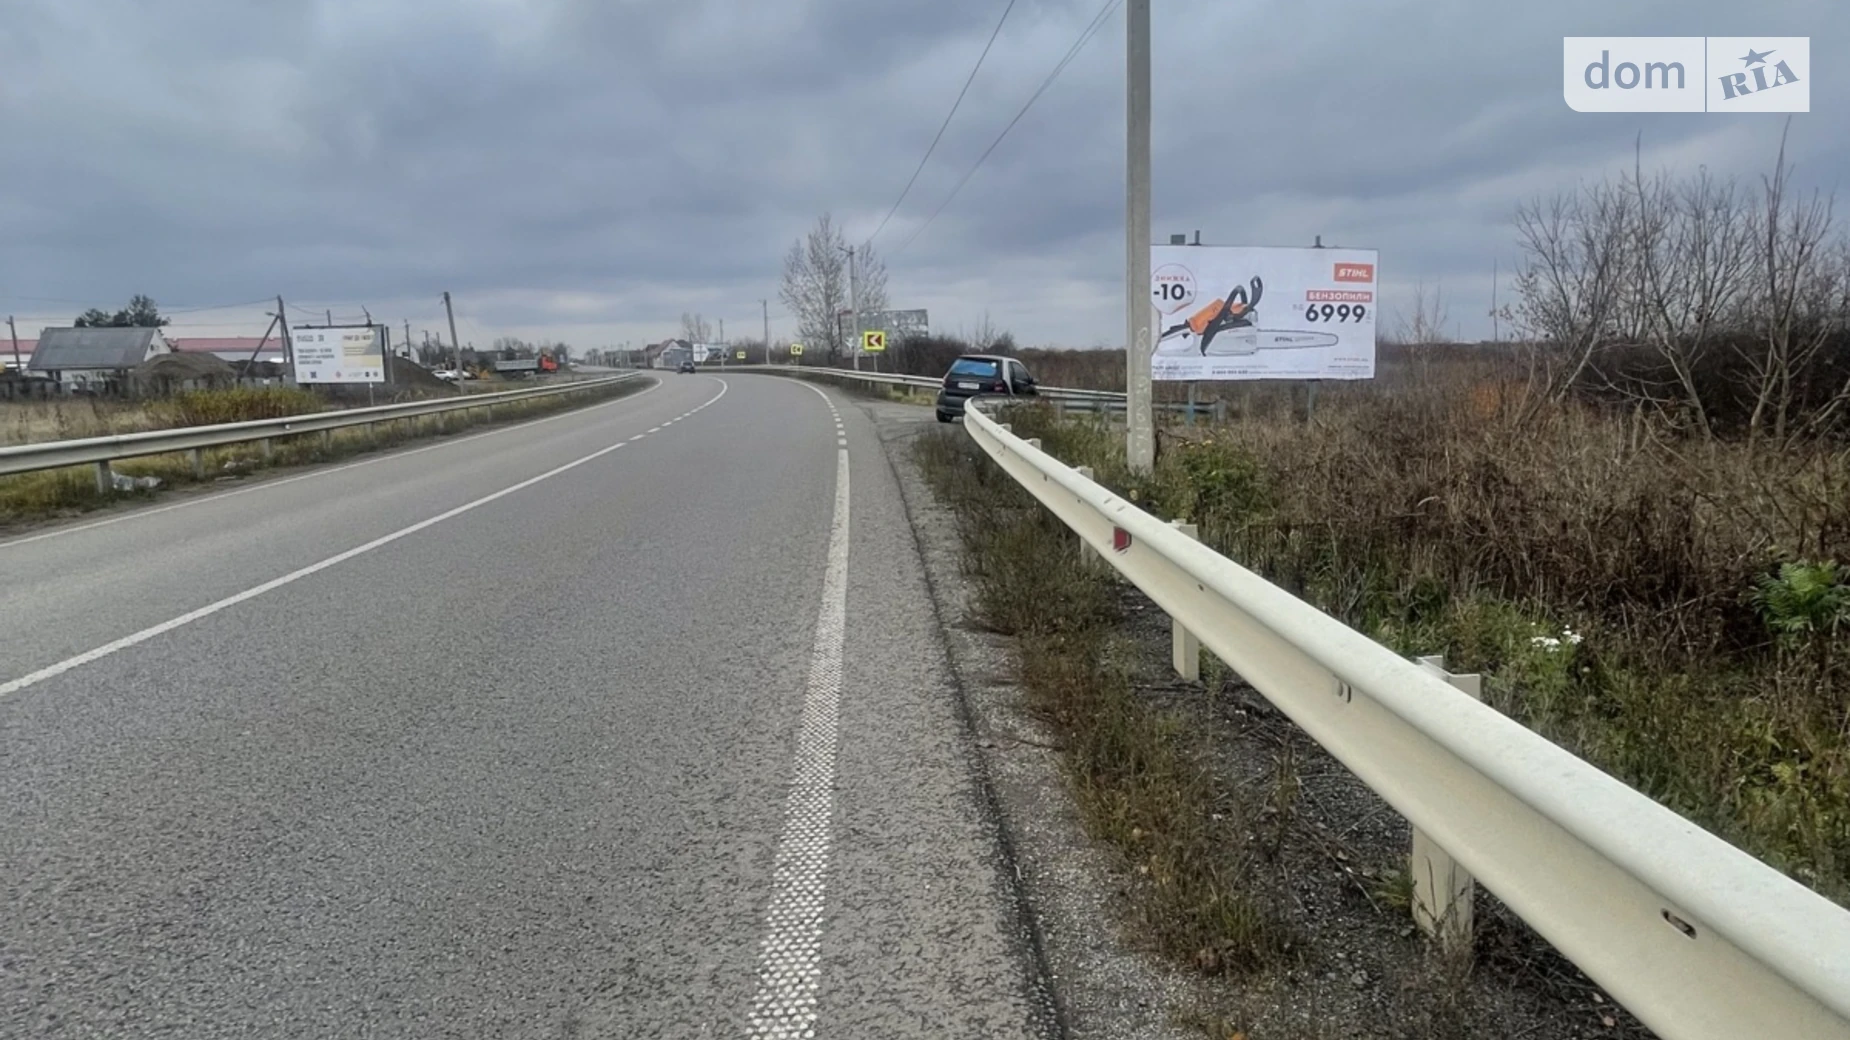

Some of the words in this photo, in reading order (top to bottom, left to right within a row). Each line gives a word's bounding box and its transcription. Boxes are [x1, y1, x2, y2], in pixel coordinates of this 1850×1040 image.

[1338, 268, 1369, 278] STIHL
[1308, 291, 1371, 301] БЕНЗОПИЛИ
[1305, 303, 1366, 323] 6999
